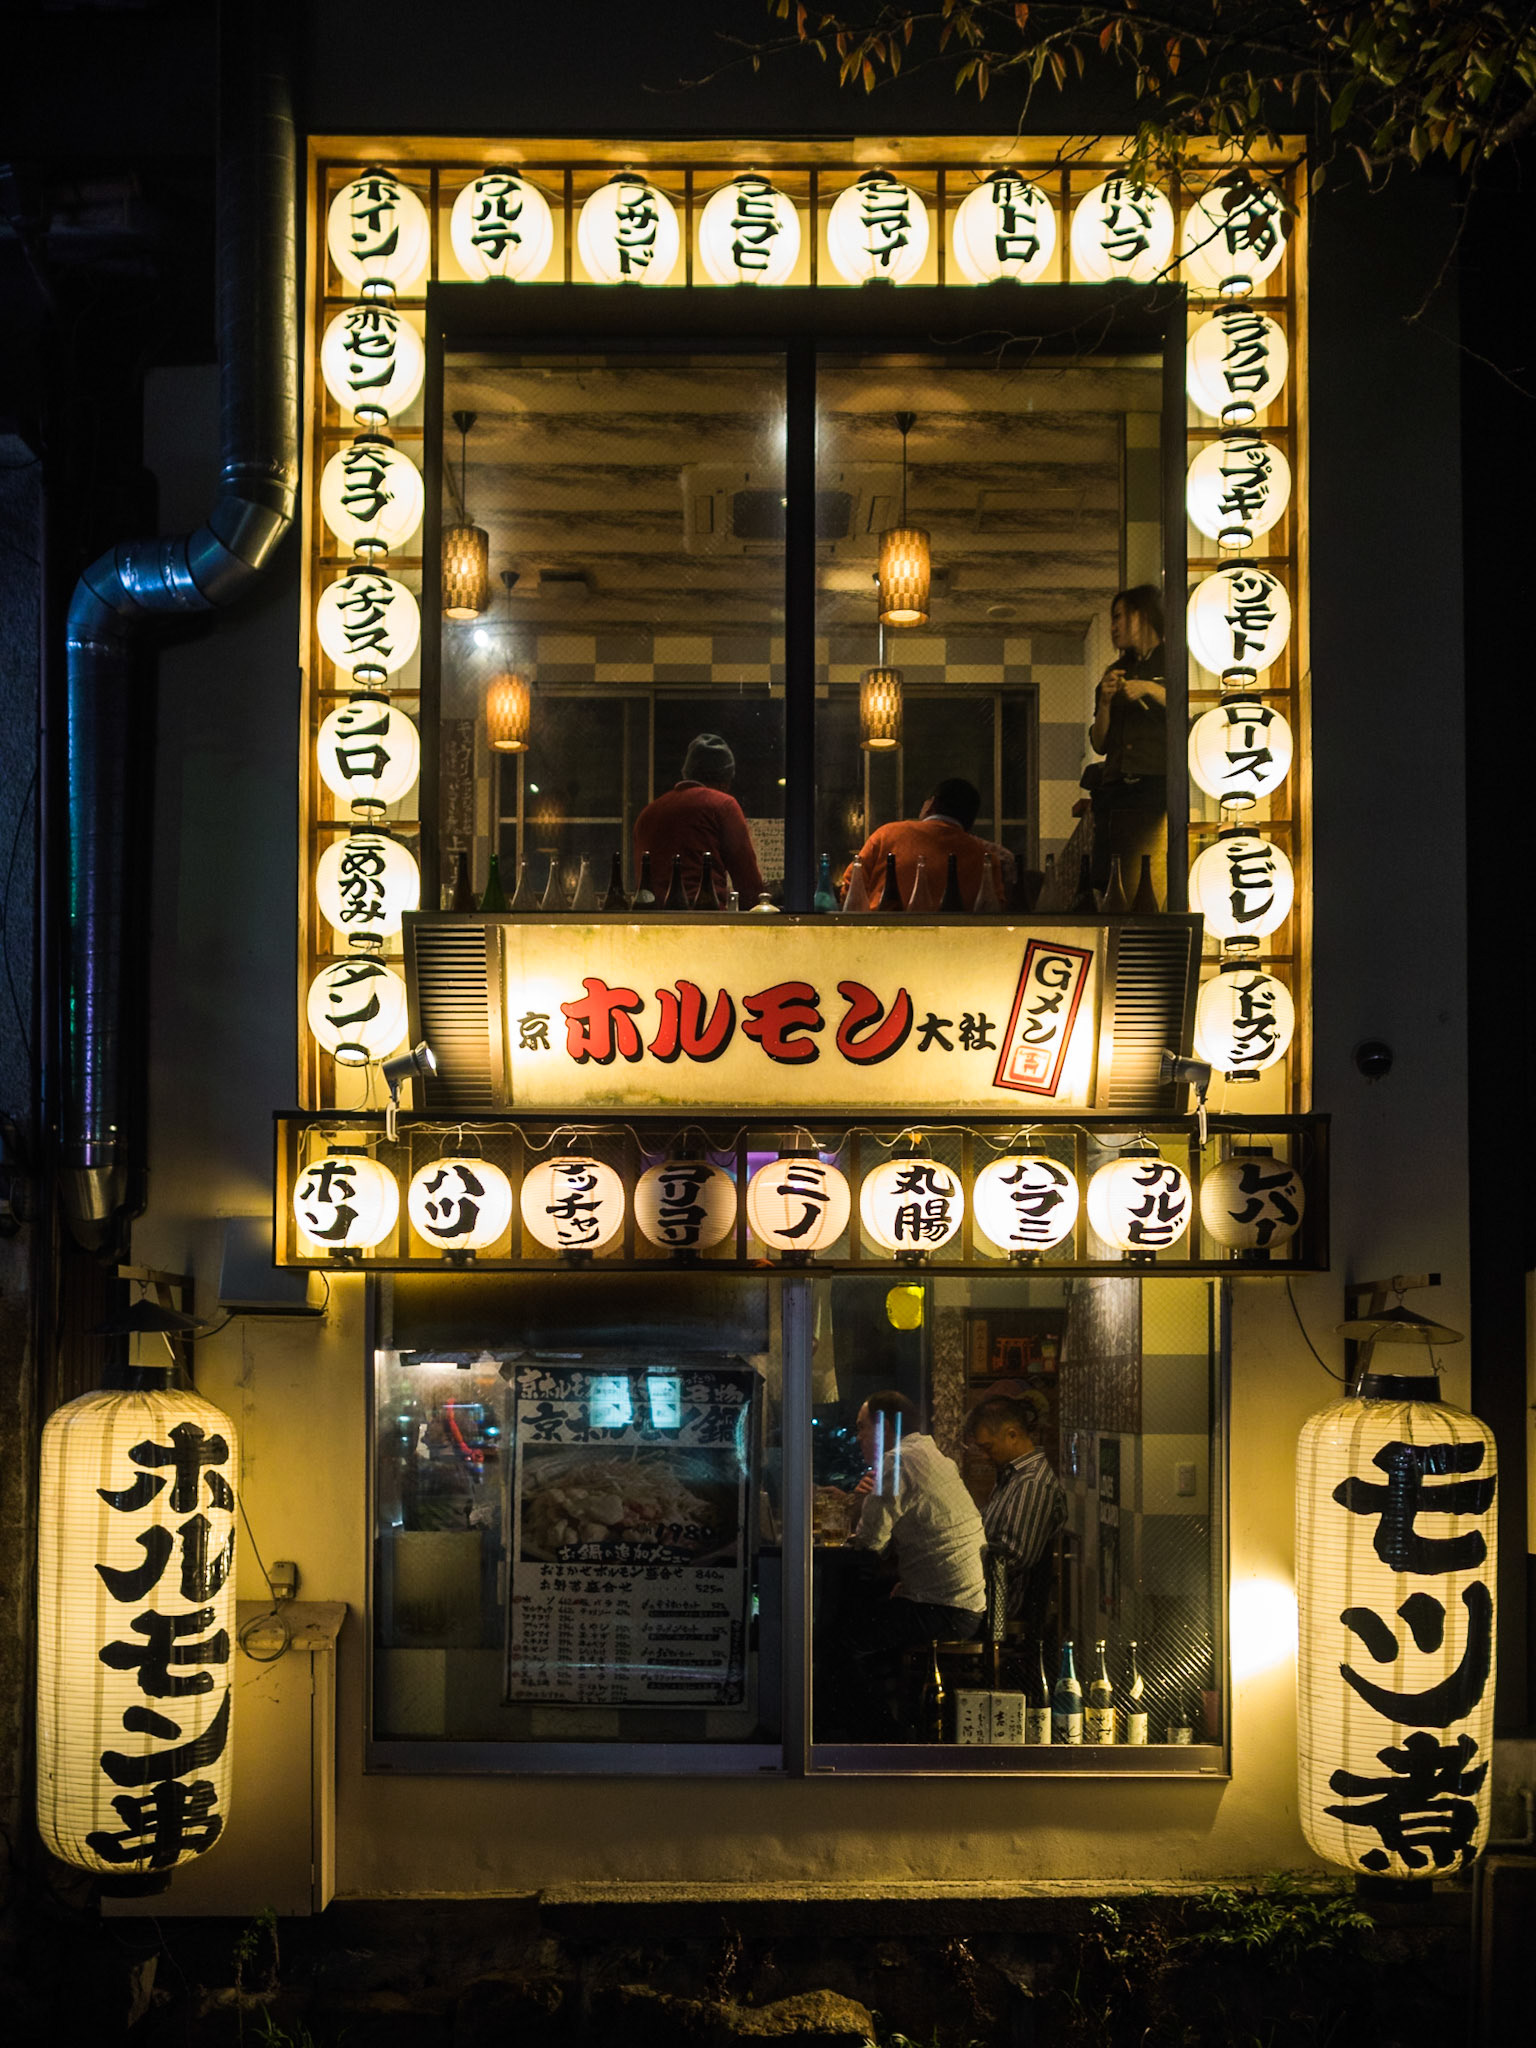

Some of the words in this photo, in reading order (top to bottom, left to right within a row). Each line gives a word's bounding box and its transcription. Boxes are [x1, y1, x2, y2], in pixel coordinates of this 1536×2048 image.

[469, 176, 523, 260] ウルテ
[856, 179, 912, 267] センマイ
[991, 179, 1046, 263] 豚トロ
[335, 576, 397, 656] ハチノス
[1221, 569, 1279, 661] ハツモト
[334, 707, 392, 779] シロ
[1220, 705, 1276, 782] ロース
[338, 838, 387, 923] こめかみ
[1226, 841, 1276, 924] シビレ
[325, 961, 389, 1029] タン
[515, 977, 998, 1066] 京ホルモン大社
[1022, 955, 1074, 1045] Gメン
[1228, 974, 1281, 1066] ノドスジ
[300, 1160, 360, 1241] ホソ
[423, 1164, 487, 1238] ハツ
[545, 1160, 604, 1247] テッチャン
[656, 1164, 717, 1246] コリコリ
[773, 1165, 831, 1239] ミノ
[889, 1164, 957, 1243] 丸腸
[998, 1161, 1070, 1243] ハラミ
[1127, 1162, 1187, 1245] カルビ
[1227, 1161, 1300, 1247] レバー
[84, 1420, 237, 1869] ホルモン串
[1322, 1439, 1498, 1870] モツ煮
